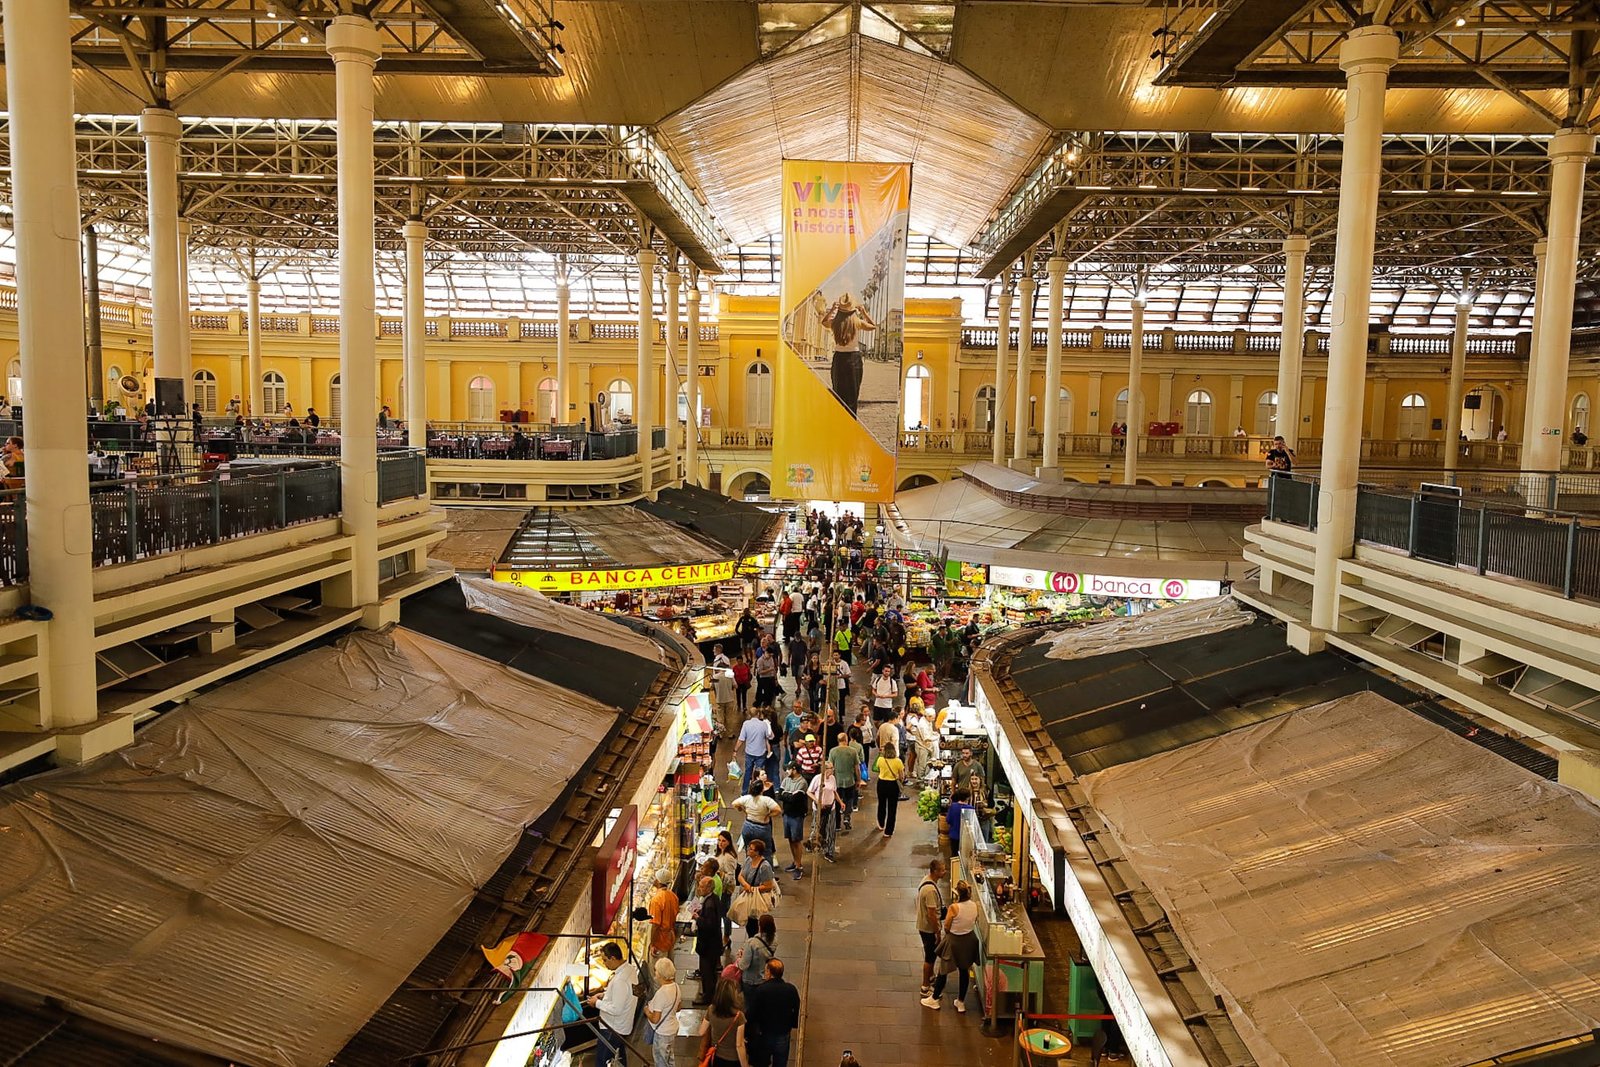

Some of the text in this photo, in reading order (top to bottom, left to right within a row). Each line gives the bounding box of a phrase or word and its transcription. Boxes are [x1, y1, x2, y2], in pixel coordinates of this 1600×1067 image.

[792, 175, 861, 204] viva
[793, 207, 854, 219] a nossa
[570, 569, 653, 585] BANCA
[661, 562, 732, 580] CENTRA
[1055, 575, 1075, 590] 10
[1092, 574, 1180, 595] banca 10
